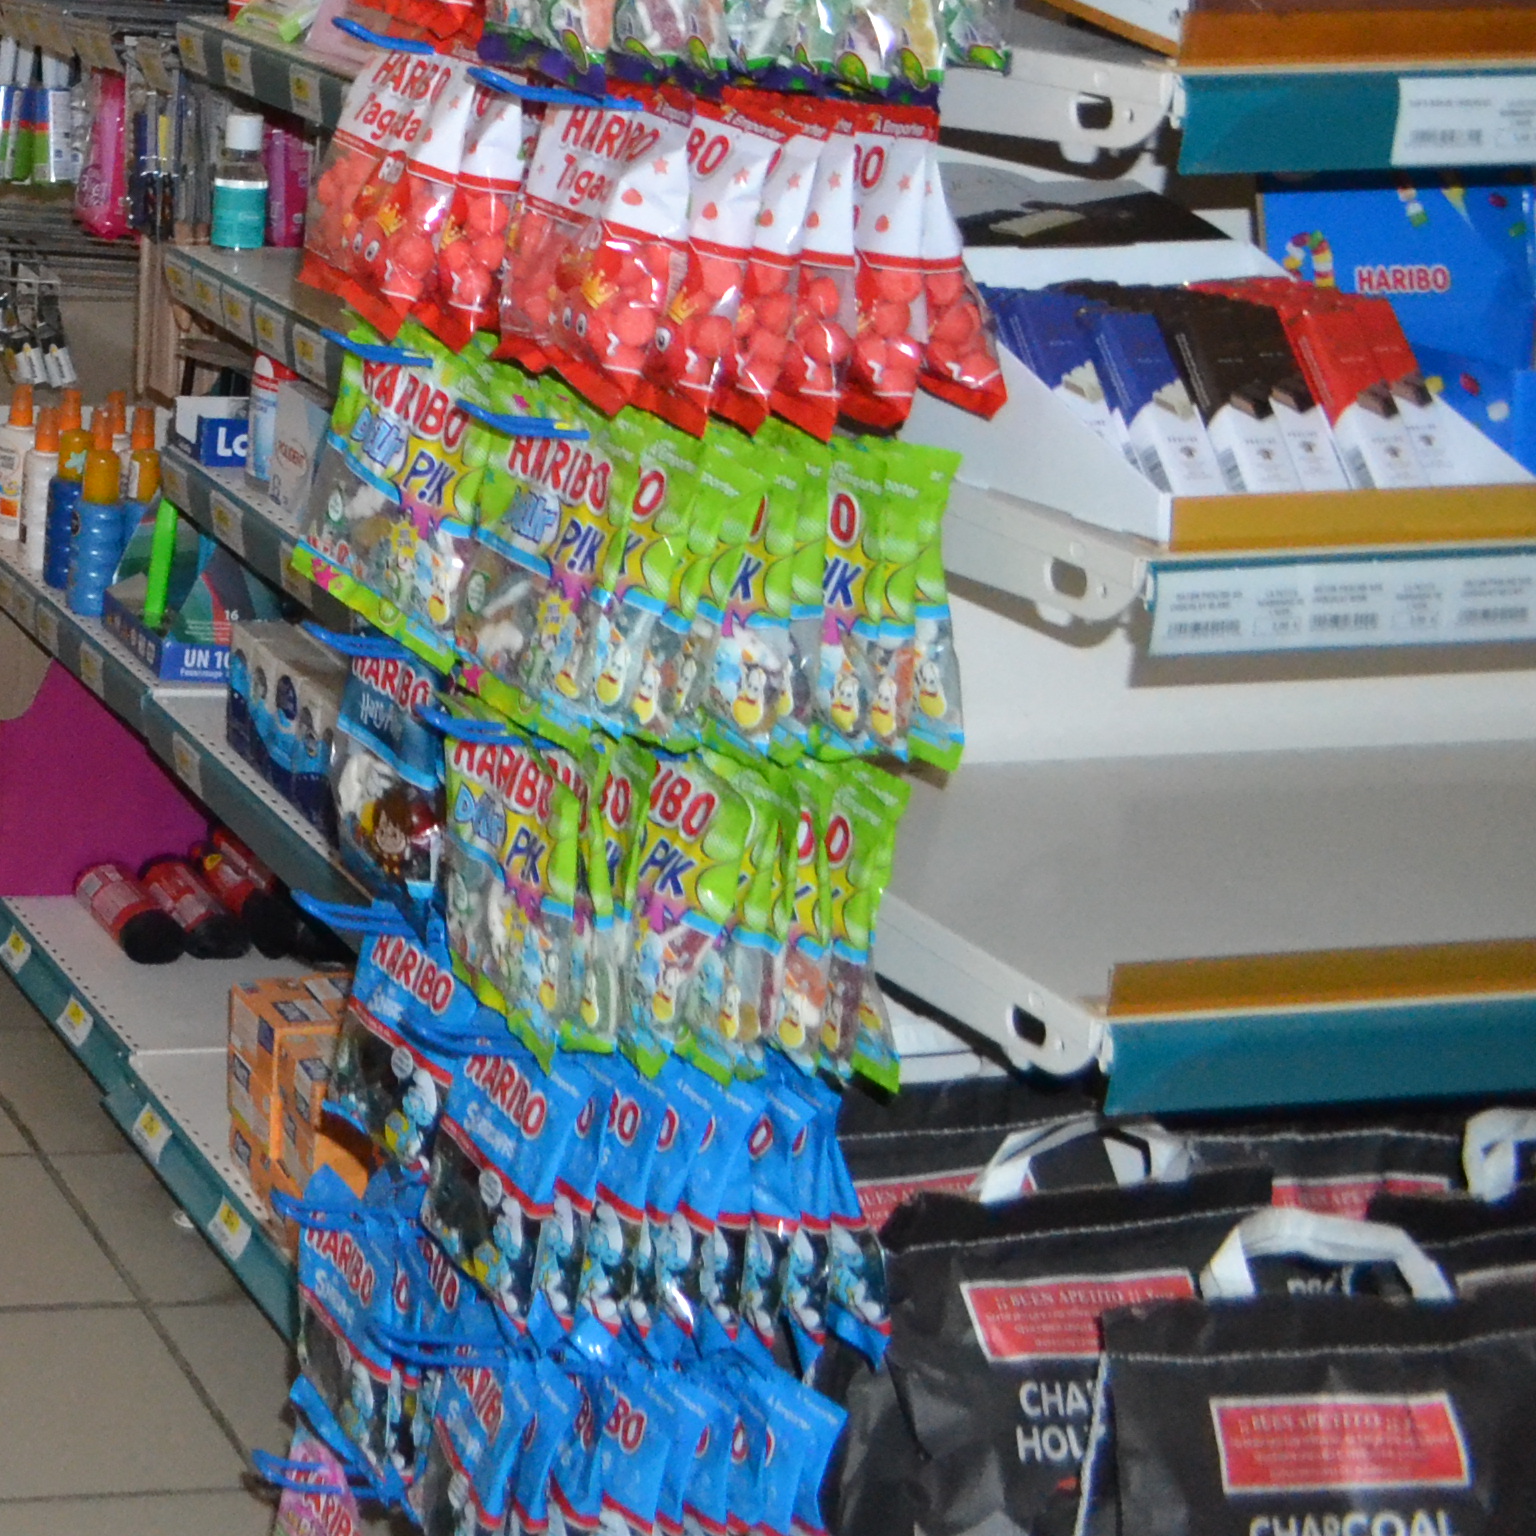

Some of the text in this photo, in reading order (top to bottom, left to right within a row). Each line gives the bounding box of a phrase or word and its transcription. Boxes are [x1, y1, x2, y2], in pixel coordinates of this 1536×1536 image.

[1355, 264, 1451, 294] HARIBO
[224, 609, 239, 621] 16
[184, 648, 210, 669] UN
[372, 935, 455, 1014] HARIBO
[1009, 1290, 1054, 1308] BUEN
[1058, 1288, 1125, 1306] APETITO
